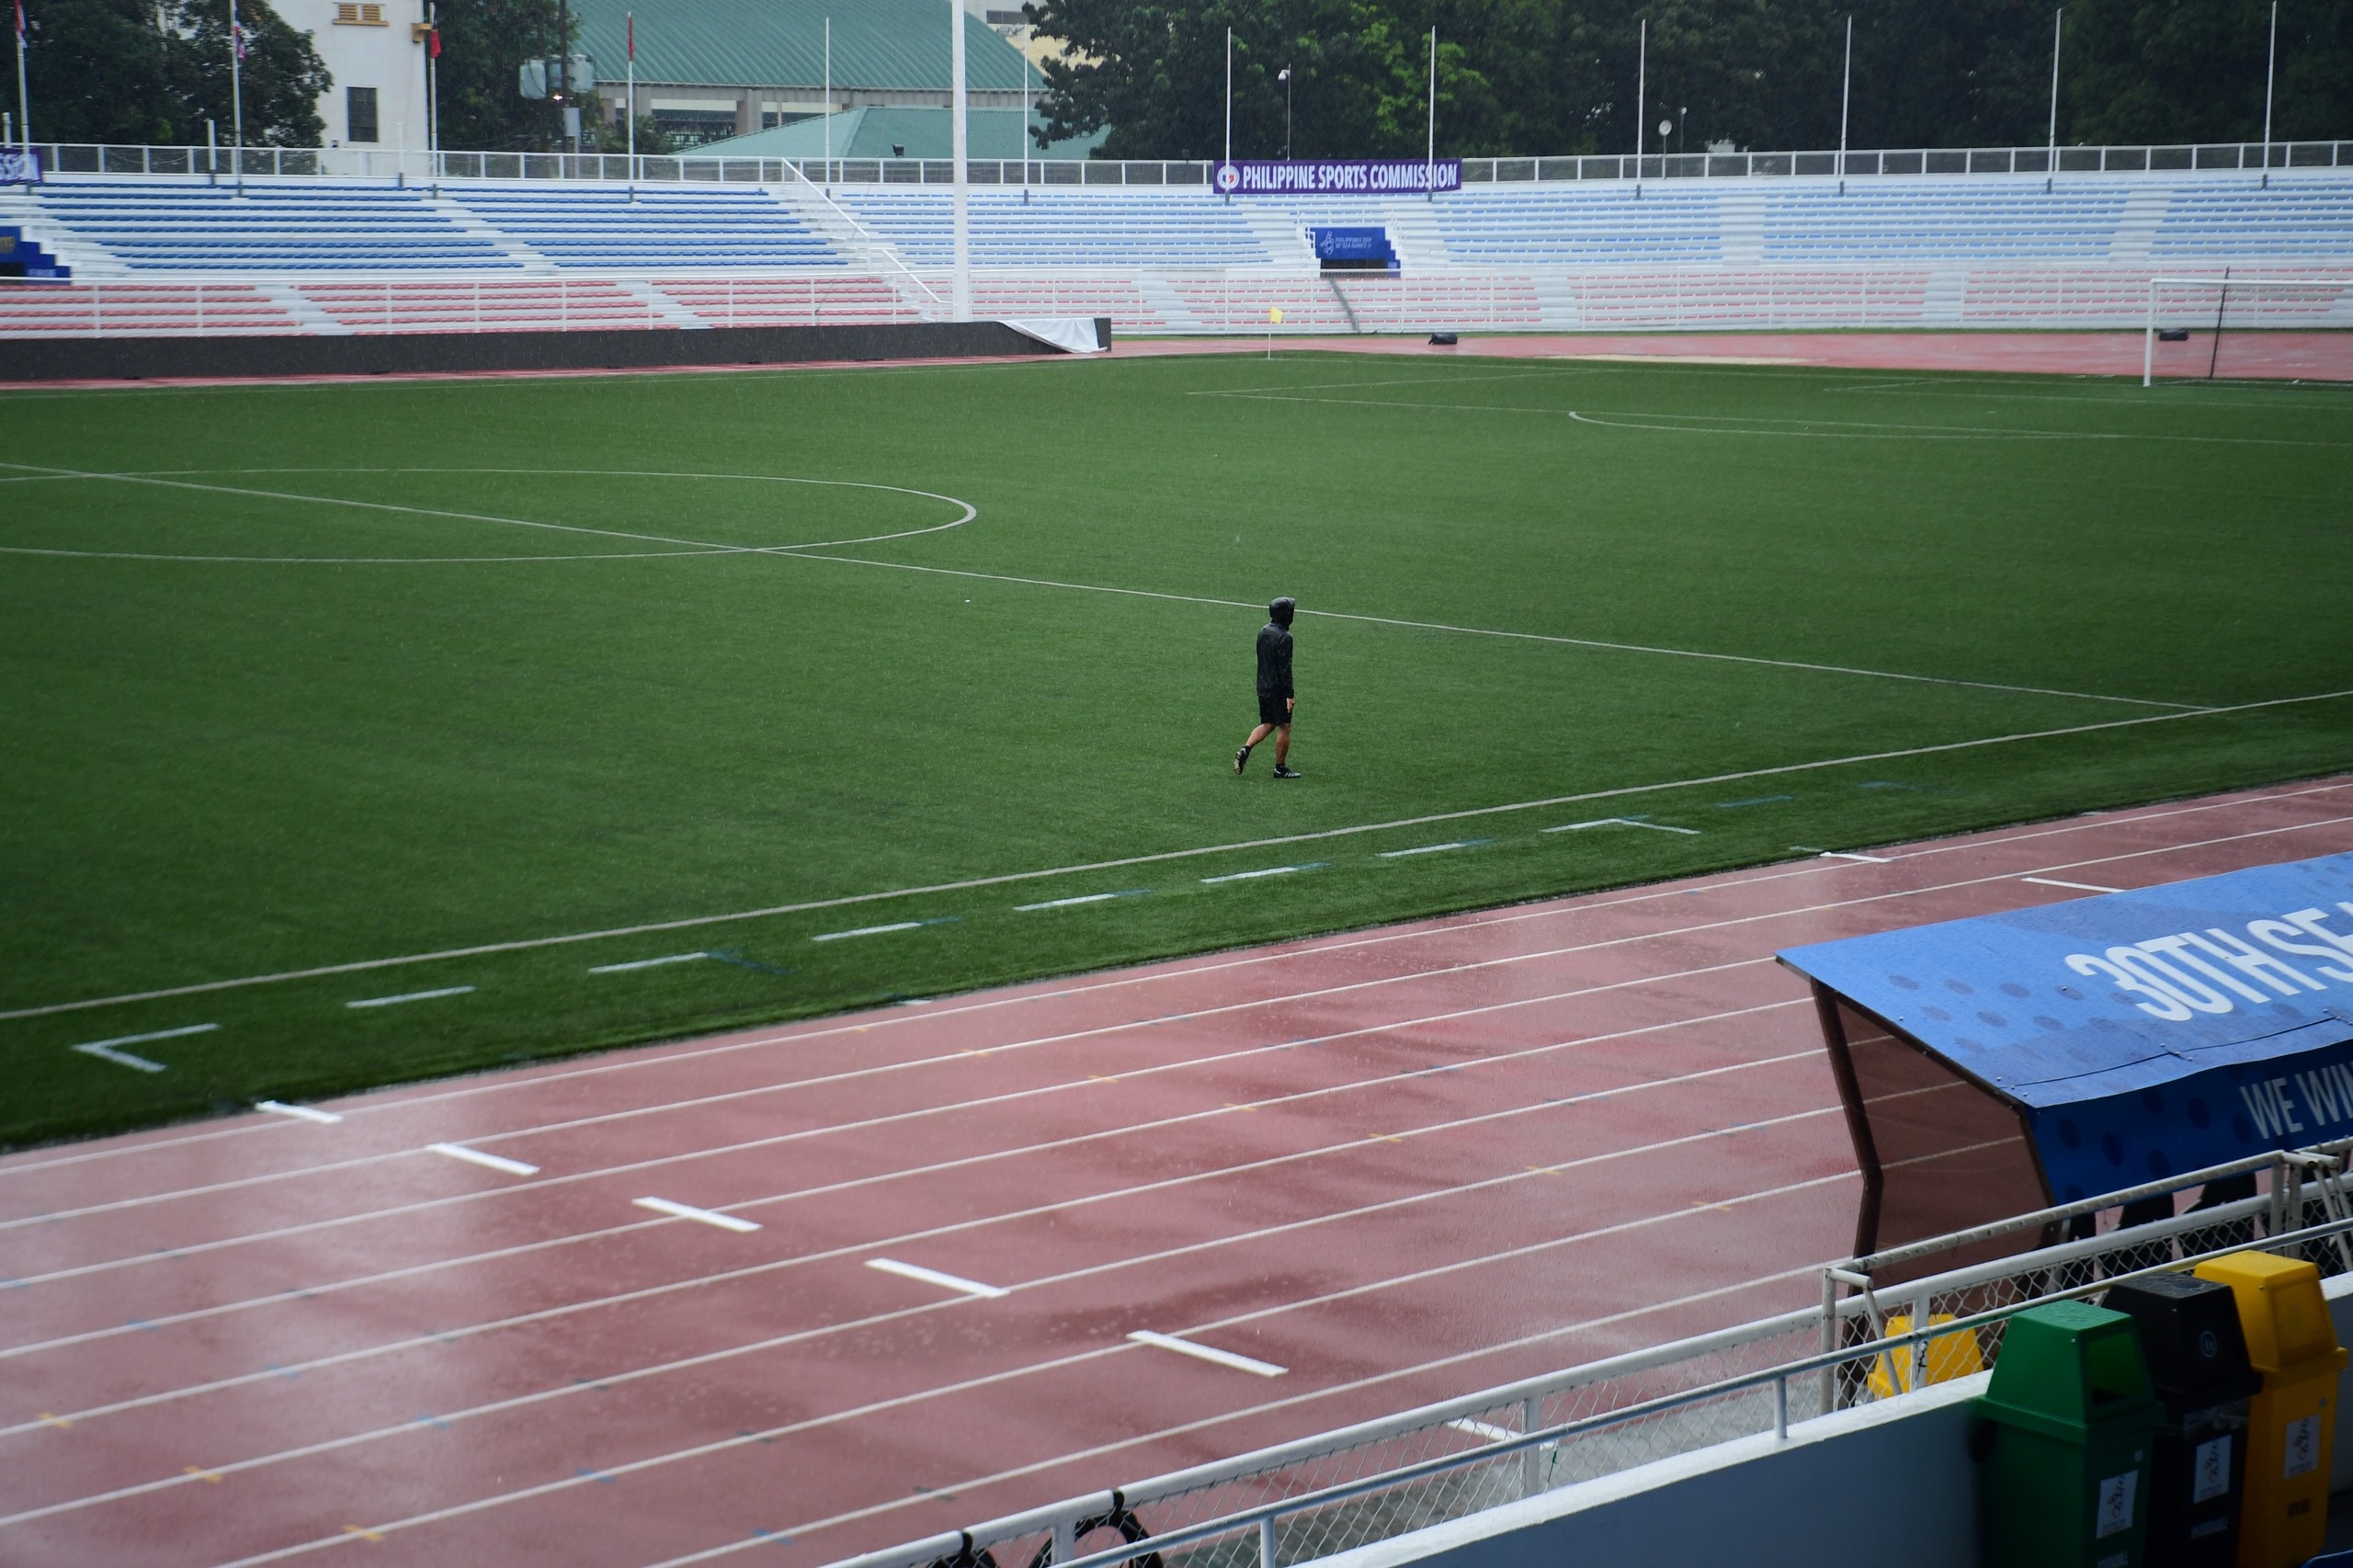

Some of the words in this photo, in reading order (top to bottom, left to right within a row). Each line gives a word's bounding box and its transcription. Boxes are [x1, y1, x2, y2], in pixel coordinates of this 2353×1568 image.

[1243, 165, 1315, 189] PHILIPPINE
[1318, 164, 1367, 189] SPORTS
[1370, 164, 1457, 189] COMMISSION
[2063, 927, 2328, 1021] 30TH
[2245, 901, 2353, 983] SE
[2240, 1077, 2304, 1139] WE
